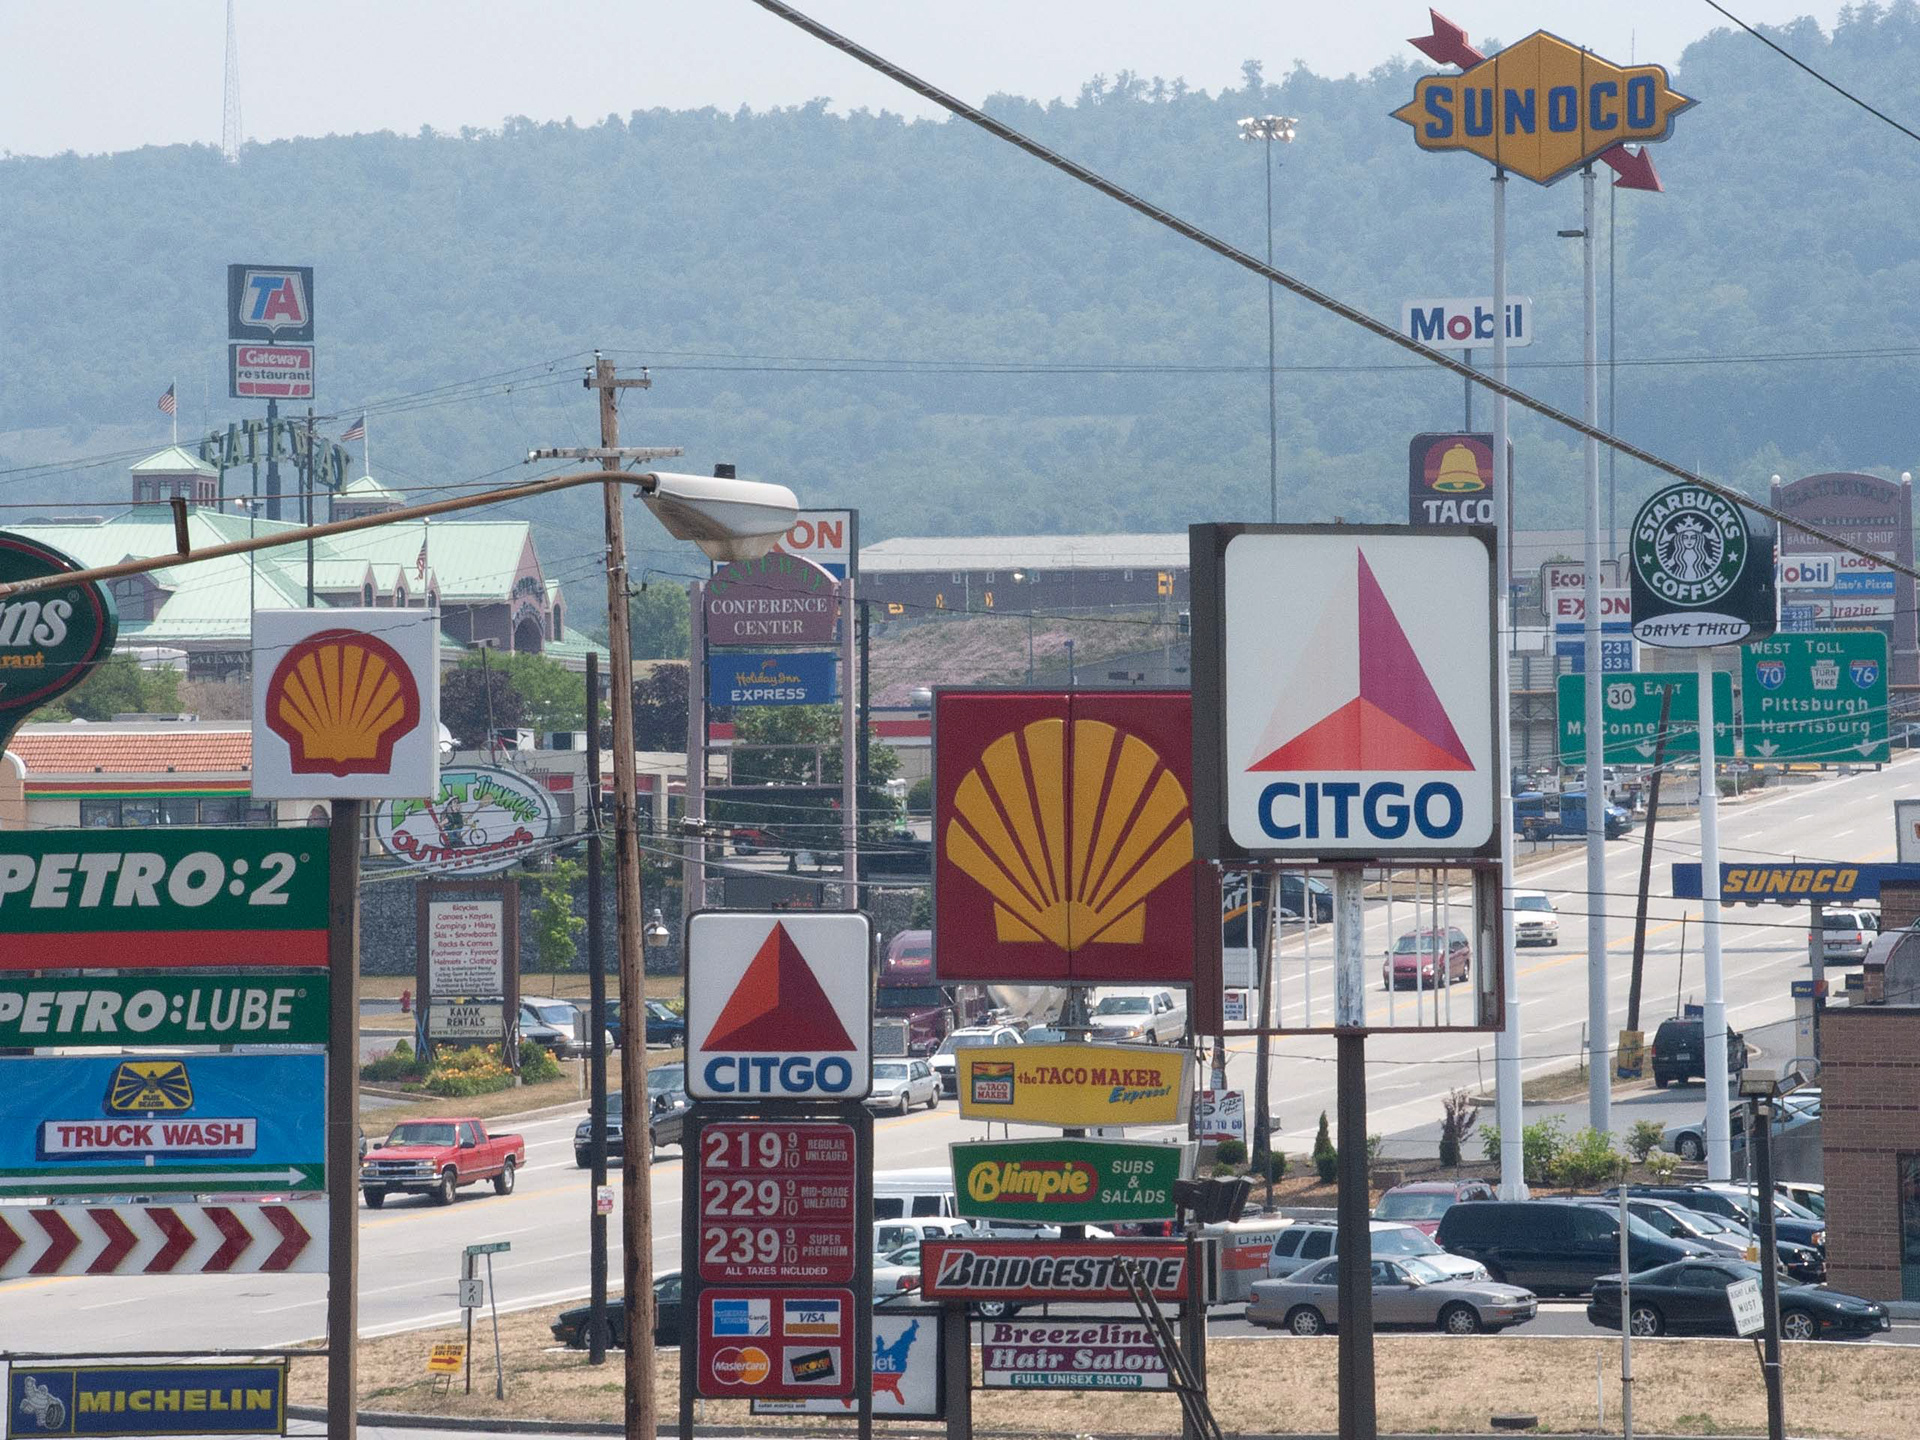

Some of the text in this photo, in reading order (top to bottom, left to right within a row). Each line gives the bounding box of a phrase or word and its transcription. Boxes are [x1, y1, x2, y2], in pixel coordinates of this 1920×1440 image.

[1424, 75, 1655, 138] SUNOCO
[250, 276, 303, 320] TA
[1410, 304, 1523, 340] Mobil
[246, 350, 302, 366] Gateway
[238, 369, 311, 380] restaurant
[1422, 499, 1494, 524] TACO
[1640, 492, 1740, 542] STARBUCKS
[1867, 531, 1895, 544] SHOP
[1780, 562, 1829, 583] obil
[1652, 571, 1728, 600] COFFEE
[1865, 579, 1893, 589] Pizza
[711, 598, 828, 614] CONFERENCE
[1557, 597, 1630, 620] EXON
[734, 620, 804, 636] CENTER
[1642, 623, 1742, 637] DRIVE THRU
[1750, 640, 1845, 654] WEST TOLL
[0, 652, 45, 668] rant
[736, 672, 801, 686] Holiday Inn
[1760, 668, 1782, 684] 70
[1815, 667, 1875, 683] TURN 76
[1815, 678, 1836, 687] PIKE
[731, 688, 806, 701] EXPRESS
[1611, 682, 1683, 704] 30 EAT
[1762, 698, 1869, 714] Pittsburgh
[1761, 719, 1871, 736] Harrisburg
[473, 775, 542, 822] Jimmy's
[1258, 782, 1463, 839] CITGO
[0, 851, 297, 908] PETRO:2
[1723, 869, 1858, 893] SUNOCO
[453, 904, 479, 912] Bicycles
[469, 913, 493, 921] Kayaks
[435, 922, 496, 931] Camping Hiking
[455, 931, 497, 939] Snowboards
[469, 957, 497, 966] Clothing
[470, 949, 499, 958] Eyewear
[0, 989, 296, 1033] PETRO:LUBE
[450, 1008, 480, 1016] KAYAK
[447, 1018, 486, 1026] RENTALS
[704, 1056, 853, 1093] CITGO
[1036, 1067, 1087, 1085] TACO
[1091, 1068, 1162, 1087] MAKER
[978, 1091, 1009, 1099] MAKER
[986, 1083, 1008, 1092] TACO
[1109, 1086, 1171, 1104] Express!
[57, 1122, 244, 1148] TRUCK WASH
[705, 1132, 782, 1168] 219
[807, 1139, 846, 1150] REGULAR
[805, 1151, 848, 1161] UNLEADED
[1112, 1160, 1154, 1174] SUBS
[968, 1161, 1089, 1204] Blimpie
[1128, 1177, 1139, 1188] &
[704, 1180, 780, 1216] 229
[801, 1186, 849, 1197] MID-GRADE
[803, 1198, 847, 1209] UNLEADED
[1101, 1189, 1166, 1204] SALADS
[704, 1228, 780, 1264] 239
[809, 1234, 842, 1245] SUPER
[802, 1246, 848, 1256] PREMIUM
[725, 1266, 828, 1276] ALL TAXES INCLUDED
[1737, 1299, 1757, 1313] MUST
[800, 1313, 826, 1323] VISA
[991, 1324, 1160, 1345] Breezeline
[715, 1361, 767, 1371] MasterCard
[990, 1349, 1165, 1371] Hair Salon
[1014, 1374, 1138, 1386] FULL UNISEX SALON
[78, 1389, 272, 1413] MICHELIN
